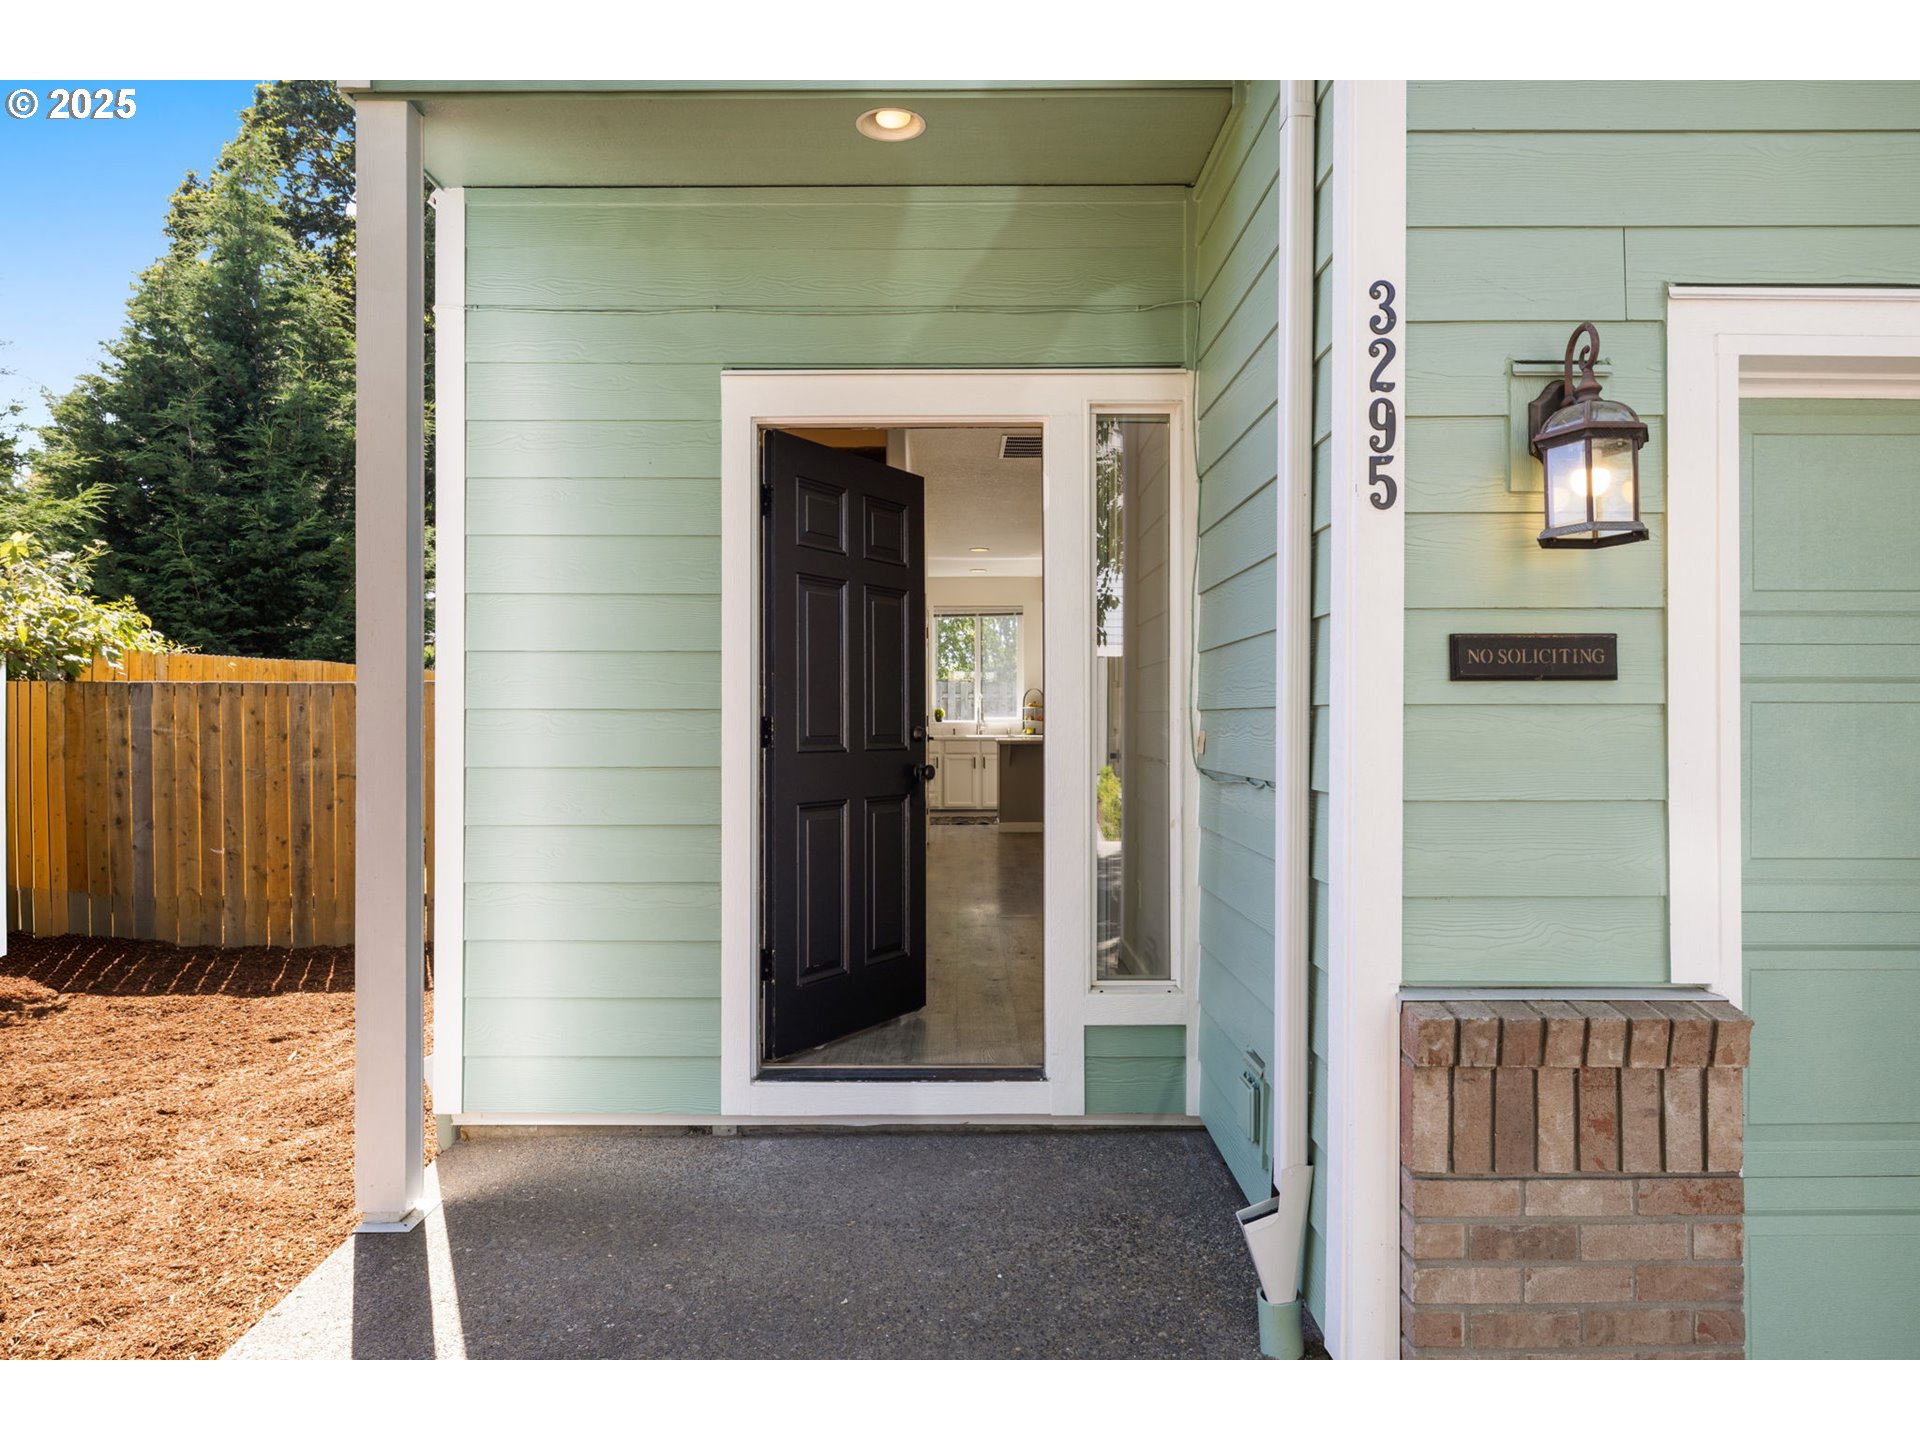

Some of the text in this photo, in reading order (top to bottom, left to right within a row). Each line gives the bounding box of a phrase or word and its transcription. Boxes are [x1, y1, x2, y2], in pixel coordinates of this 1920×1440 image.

[1368, 280, 1397, 510] 3295
[1467, 648, 1605, 664] NO SOLICITING
